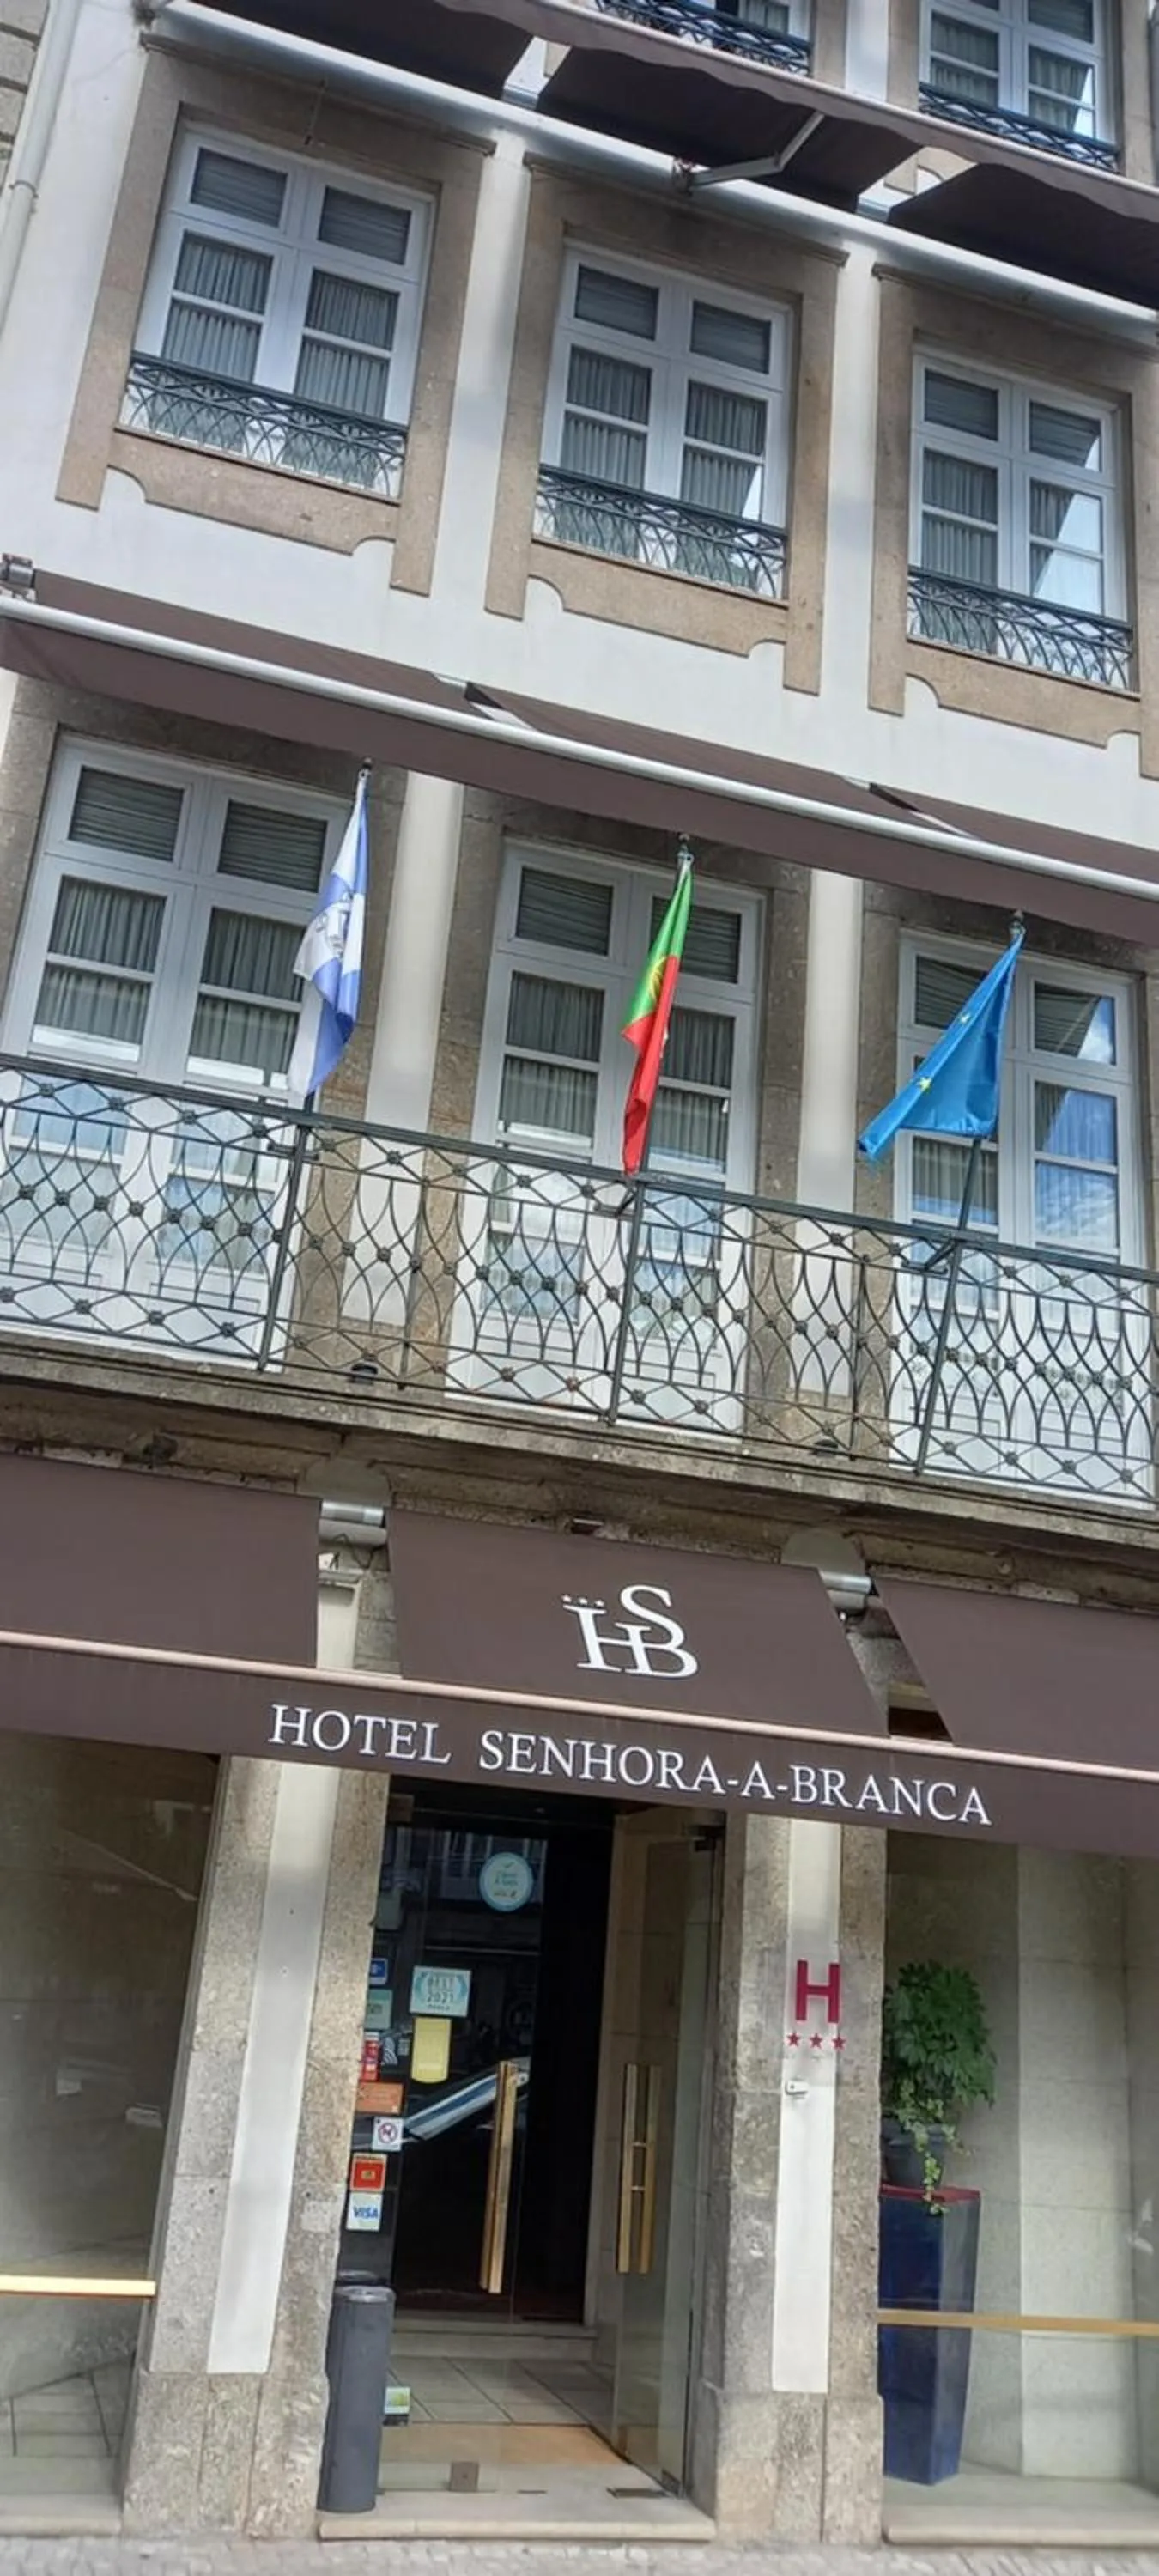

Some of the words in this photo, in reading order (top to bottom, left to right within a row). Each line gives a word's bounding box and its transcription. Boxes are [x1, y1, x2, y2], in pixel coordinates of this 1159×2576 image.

[268, 1704, 452, 1766] HOTEL
[478, 1729, 993, 1826] SENHORA-A-BRANCA
[795, 1959, 840, 2023] H
[353, 2206, 379, 2218] VISA
